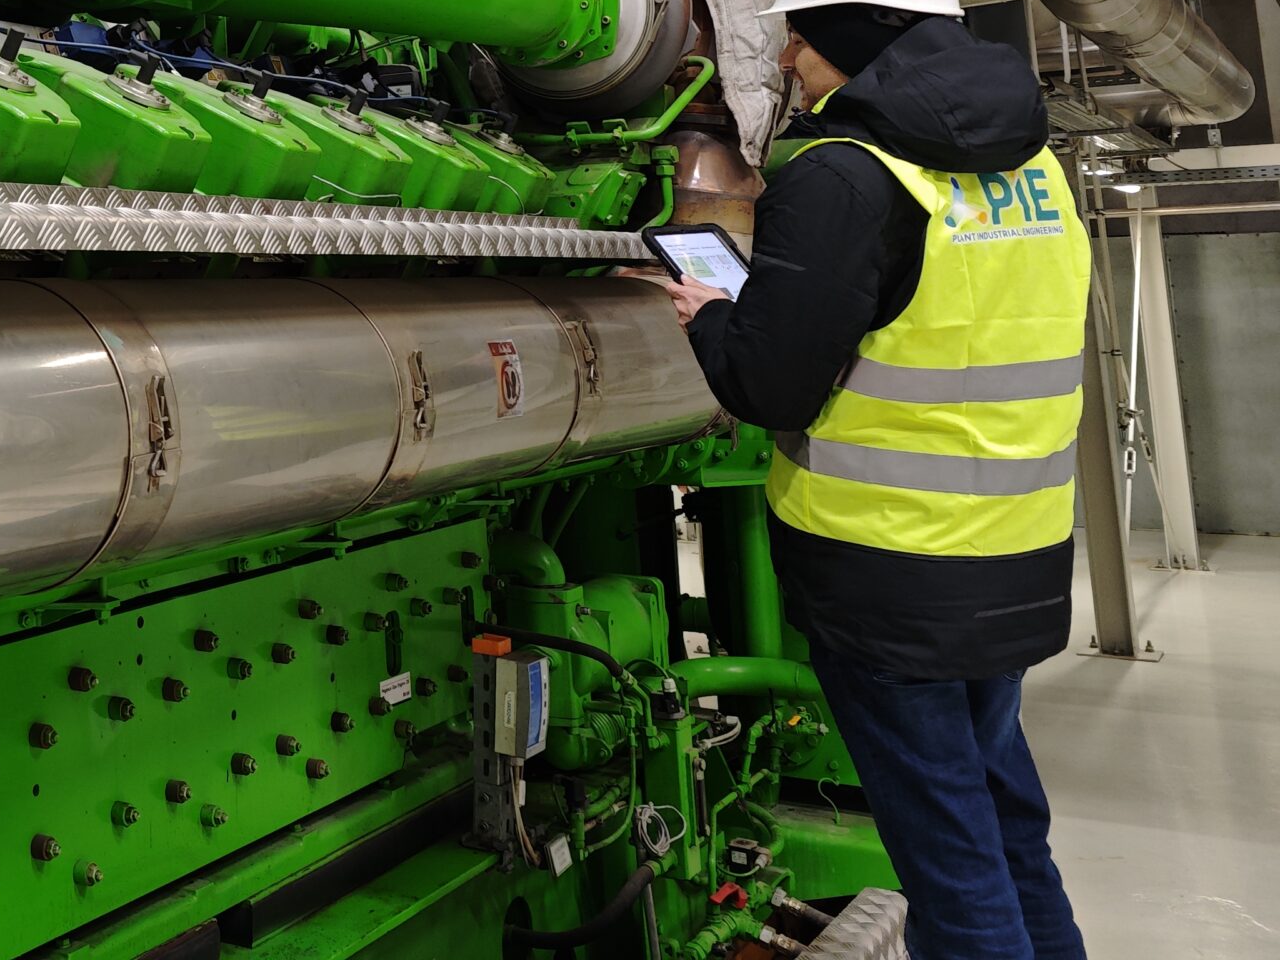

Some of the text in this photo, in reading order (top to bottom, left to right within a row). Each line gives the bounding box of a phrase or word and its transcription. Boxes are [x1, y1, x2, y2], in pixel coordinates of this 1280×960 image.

[952, 226, 1064, 243] PLANT INDUSTRIAL ENGINEERING
